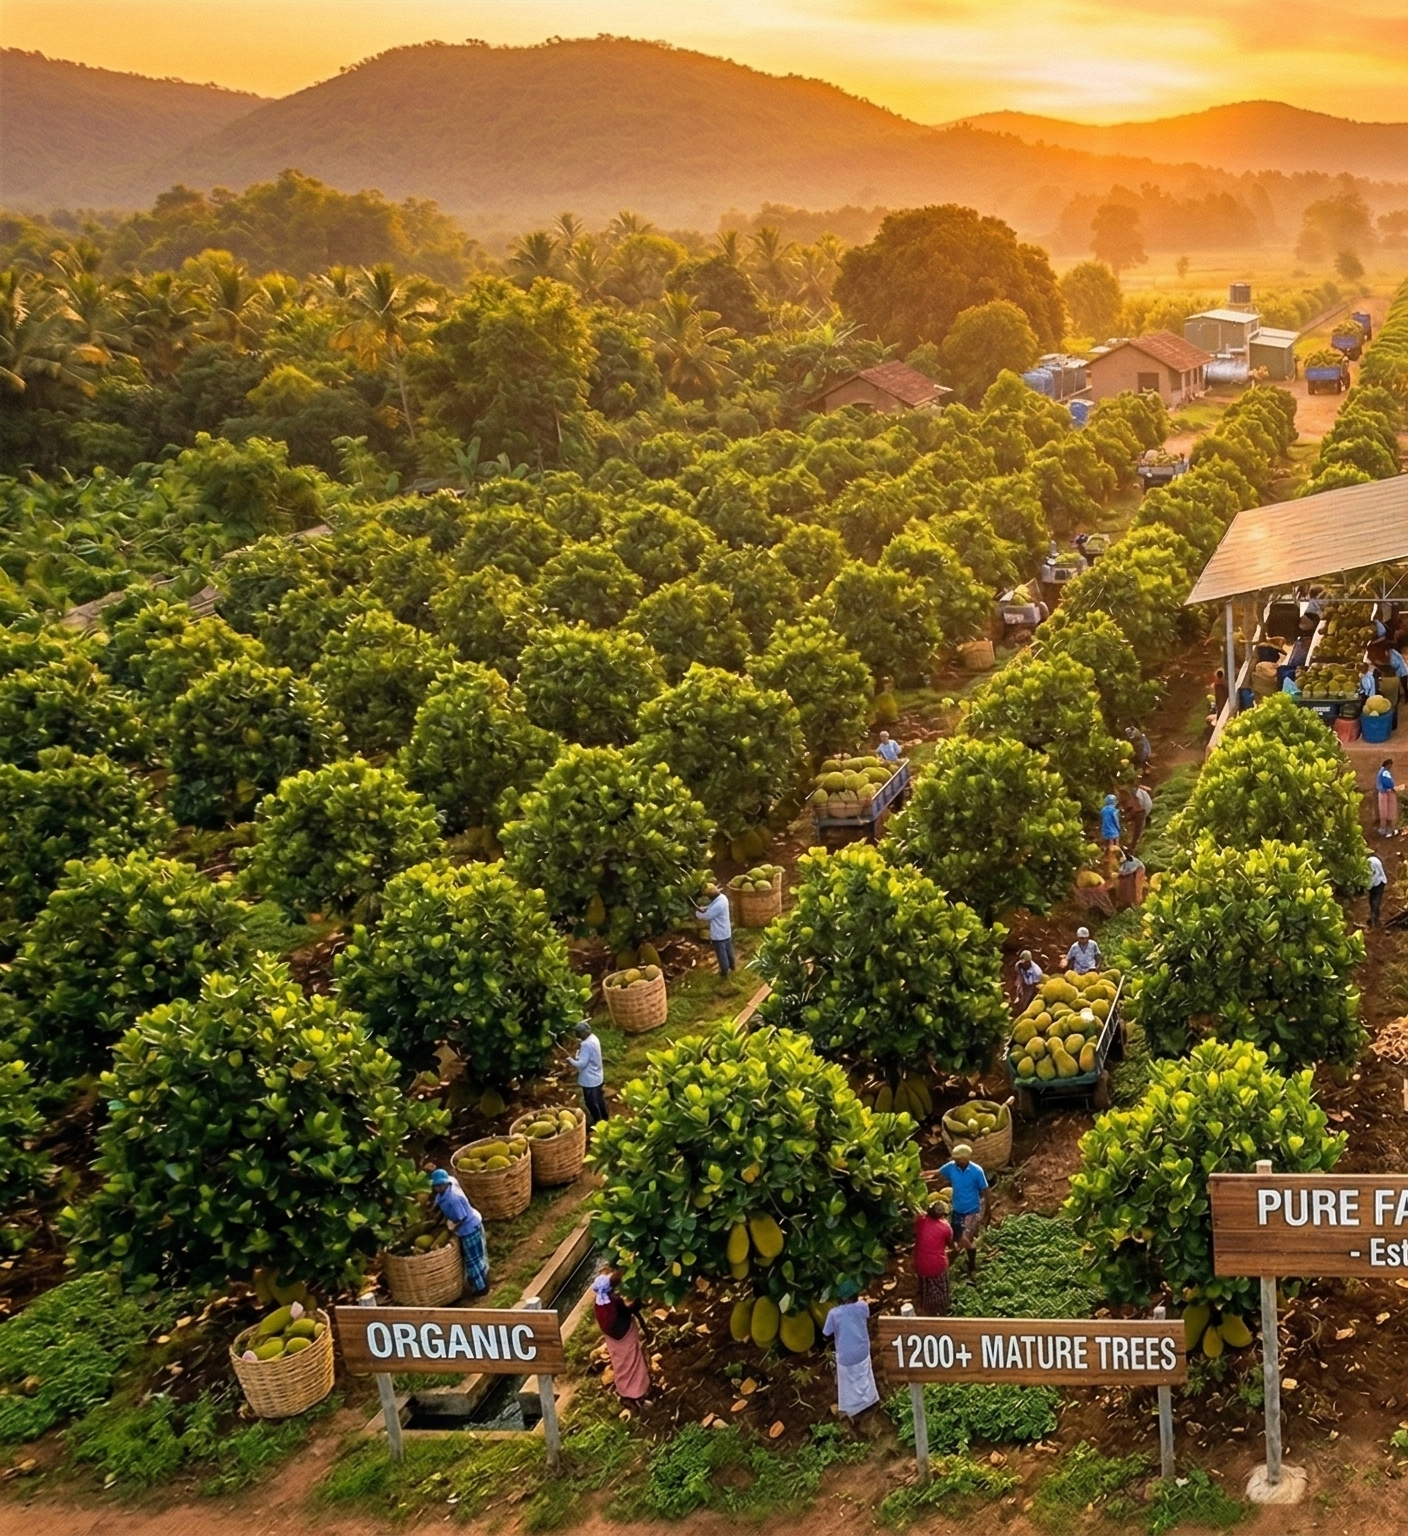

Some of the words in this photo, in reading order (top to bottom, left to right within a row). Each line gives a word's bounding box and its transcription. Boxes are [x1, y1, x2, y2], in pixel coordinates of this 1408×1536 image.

[1257, 1189, 1360, 1227] PURE
[366, 1321, 537, 1361] ORGANIC
[891, 1334, 972, 1369] 1200+
[981, 1335, 1088, 1369] MATURE
[1095, 1336, 1177, 1371] TREES
